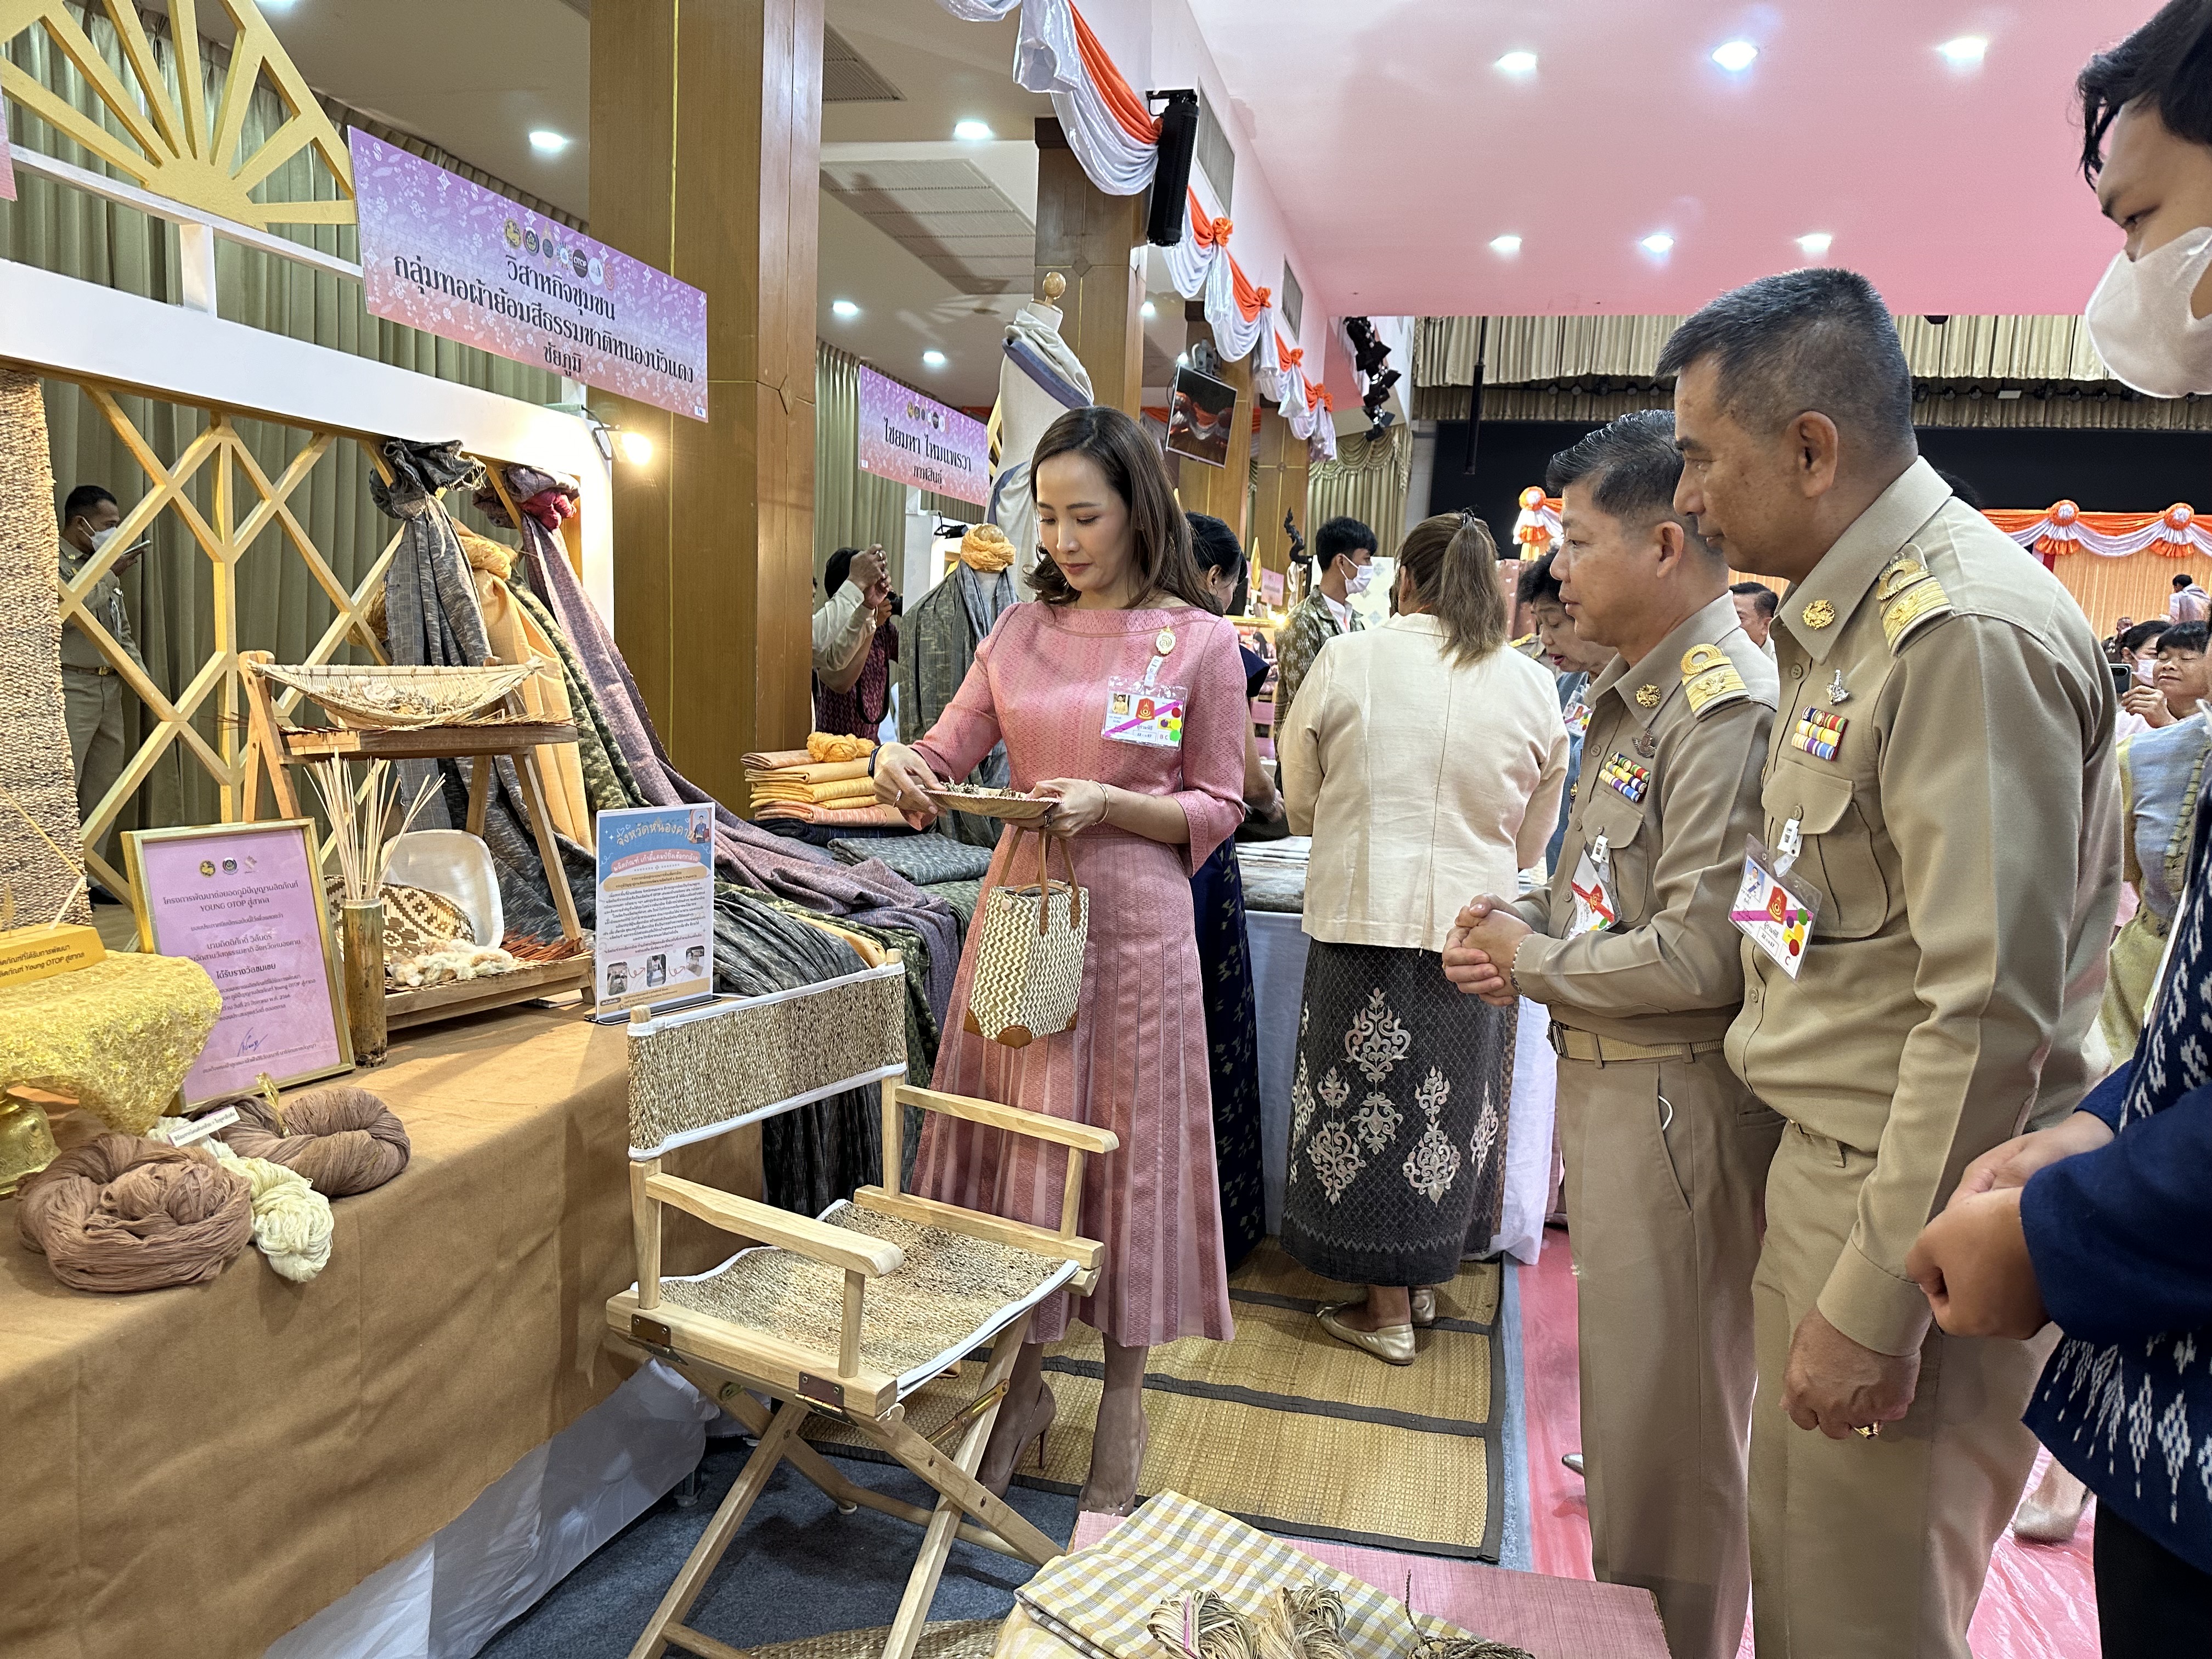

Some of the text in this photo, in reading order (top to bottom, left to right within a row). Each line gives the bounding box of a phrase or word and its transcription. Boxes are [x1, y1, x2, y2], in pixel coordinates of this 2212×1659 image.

[574, 257, 586, 267] OTOP
[506, 255, 616, 320] วิสาหกิจชุมชน
[394, 255, 693, 383] กลุ่มทอผ้าย้อมสีธรรมชาติหนองบัวแดง
[544, 342, 582, 376] ชัยภูมิ
[884, 416, 972, 472] ไชยมหา ไหมแพรวา
[913, 465, 943, 489] กาฬสินธุ์
[617, 822, 694, 846] จังหวัดหนองคาย
[200, 902, 225, 912] YOUNG
[227, 900, 246, 909] OTOP
[46, 957, 64, 966] OTOP
